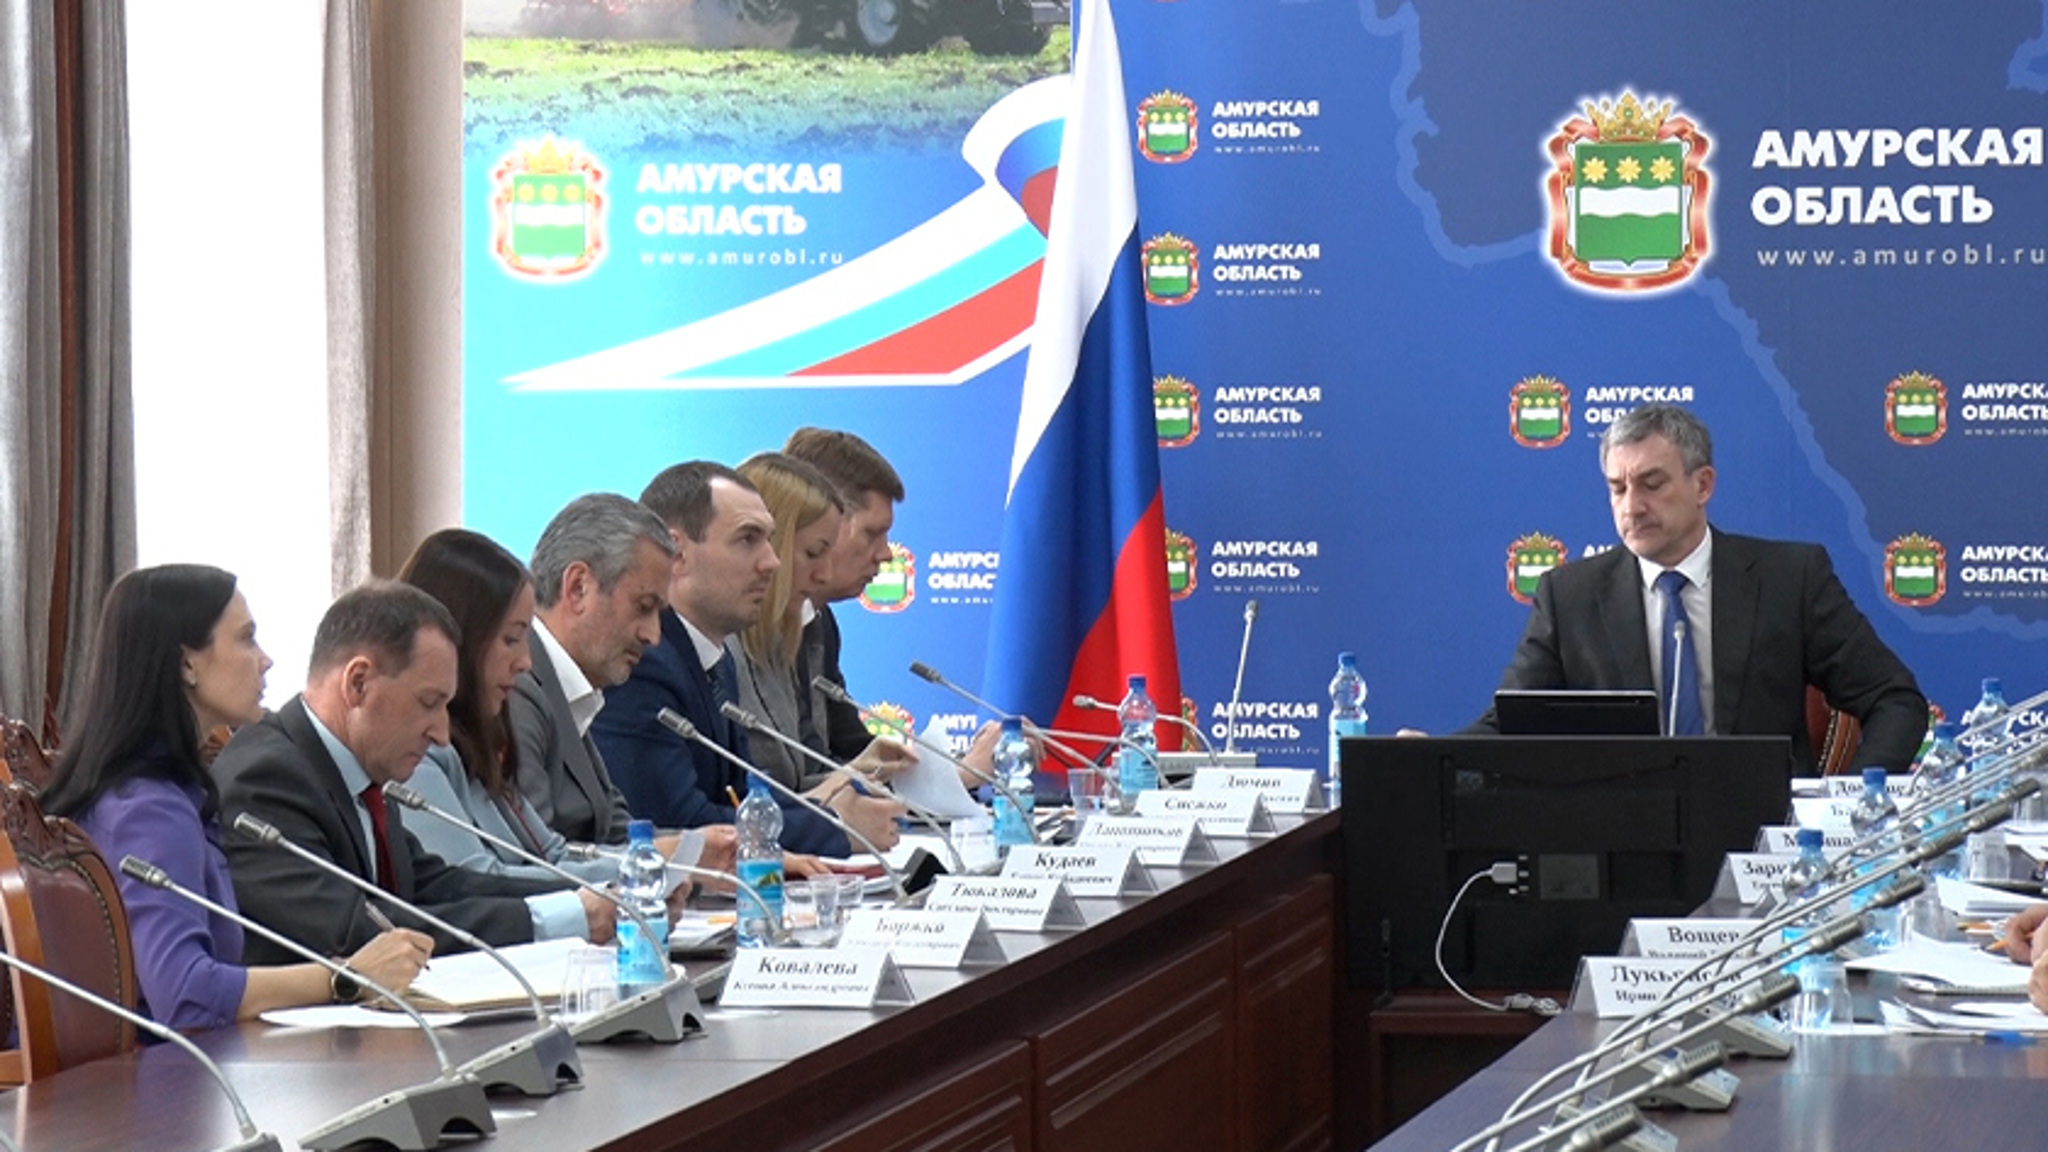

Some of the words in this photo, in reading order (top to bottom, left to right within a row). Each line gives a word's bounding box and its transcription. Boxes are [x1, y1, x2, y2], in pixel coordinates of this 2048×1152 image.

[1211, 100, 1320, 118] АМУРСКАЯ
[1211, 121, 1302, 139] ОБЛАСТЬ
[1752, 127, 2044, 168] АМУРСКАЯ
[635, 162, 843, 194] АМУРСКАЯ
[1750, 184, 1994, 225] ОБЛАСТЬ
[634, 204, 807, 236] ОБЛАСТЬ
[639, 248, 843, 265] www.amurobl.ru
[1213, 243, 1321, 260] АМУРСКАЯ
[1757, 244, 2046, 266] www.amurobl.ru
[1212, 265, 1303, 282] ОБЛАСТЬ
[1214, 386, 1322, 403] АМУРСКАЯ
[1585, 385, 1694, 402] АМУРСКАЯ
[1961, 382, 2048, 400] АМУРСК
[1213, 407, 1303, 424] ОБЛАСТЬ
[1211, 541, 1319, 558] АМУРСКАЯ
[1961, 544, 2048, 562] АМУРСК
[928, 553, 999, 570] АМУРС
[1210, 562, 1301, 579] ОБЛАСТЬ
[927, 573, 997, 590] ОБЛАС
